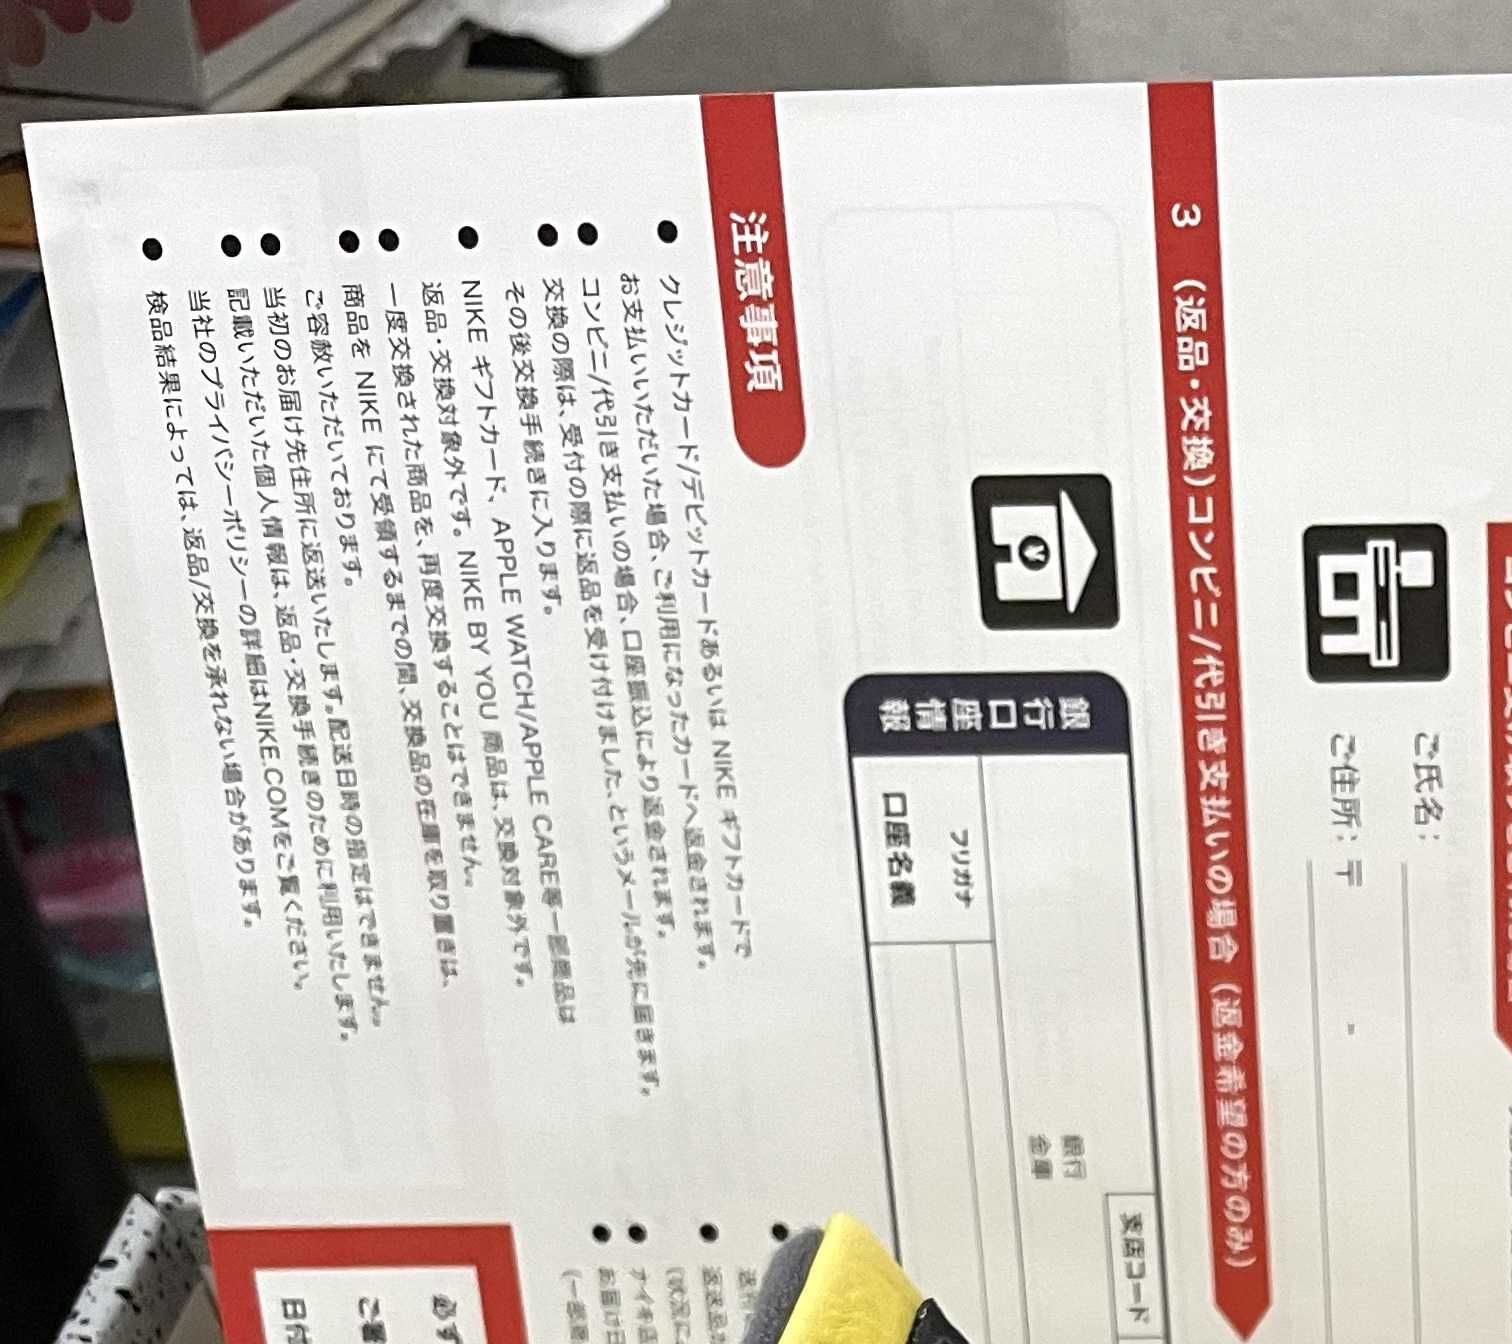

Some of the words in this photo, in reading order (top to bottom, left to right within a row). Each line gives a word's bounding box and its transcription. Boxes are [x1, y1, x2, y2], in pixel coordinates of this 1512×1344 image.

[1171, 201, 1202, 228] 3
[461, 280, 488, 343] NIKE
[729, 210, 784, 393] 注意事項
[341, 284, 371, 359] 商品を
[356, 371, 382, 434] NIKE
[422, 280, 470, 538] 返品・交換対象外です。
[304, 289, 364, 588] ご容赦いただいております。
[505, 280, 560, 616] その後交換手続きに入ります。
[659, 273, 728, 730] クレジットカード/デビットカードあるいは
[145, 290, 263, 929] 検品結果によっては、返品/交換を承れない場合があります。
[456, 550, 483, 611] NIKE
[491, 518, 522, 604] APPLE
[466, 665, 498, 720] YOU
[467, 621, 490, 656] BY
[504, 613, 550, 806] WATCH/APPLE
[877, 695, 1093, 734] 銀行口座情報
[712, 739, 737, 800] NIKE
[720, 809, 753, 959] ギフトカードで
[882, 792, 915, 908] 口座名義
[950, 828, 975, 909] フリガナ
[1061, 1134, 1088, 1181] 銀行
[1121, 1211, 1151, 1325] 支店コード
